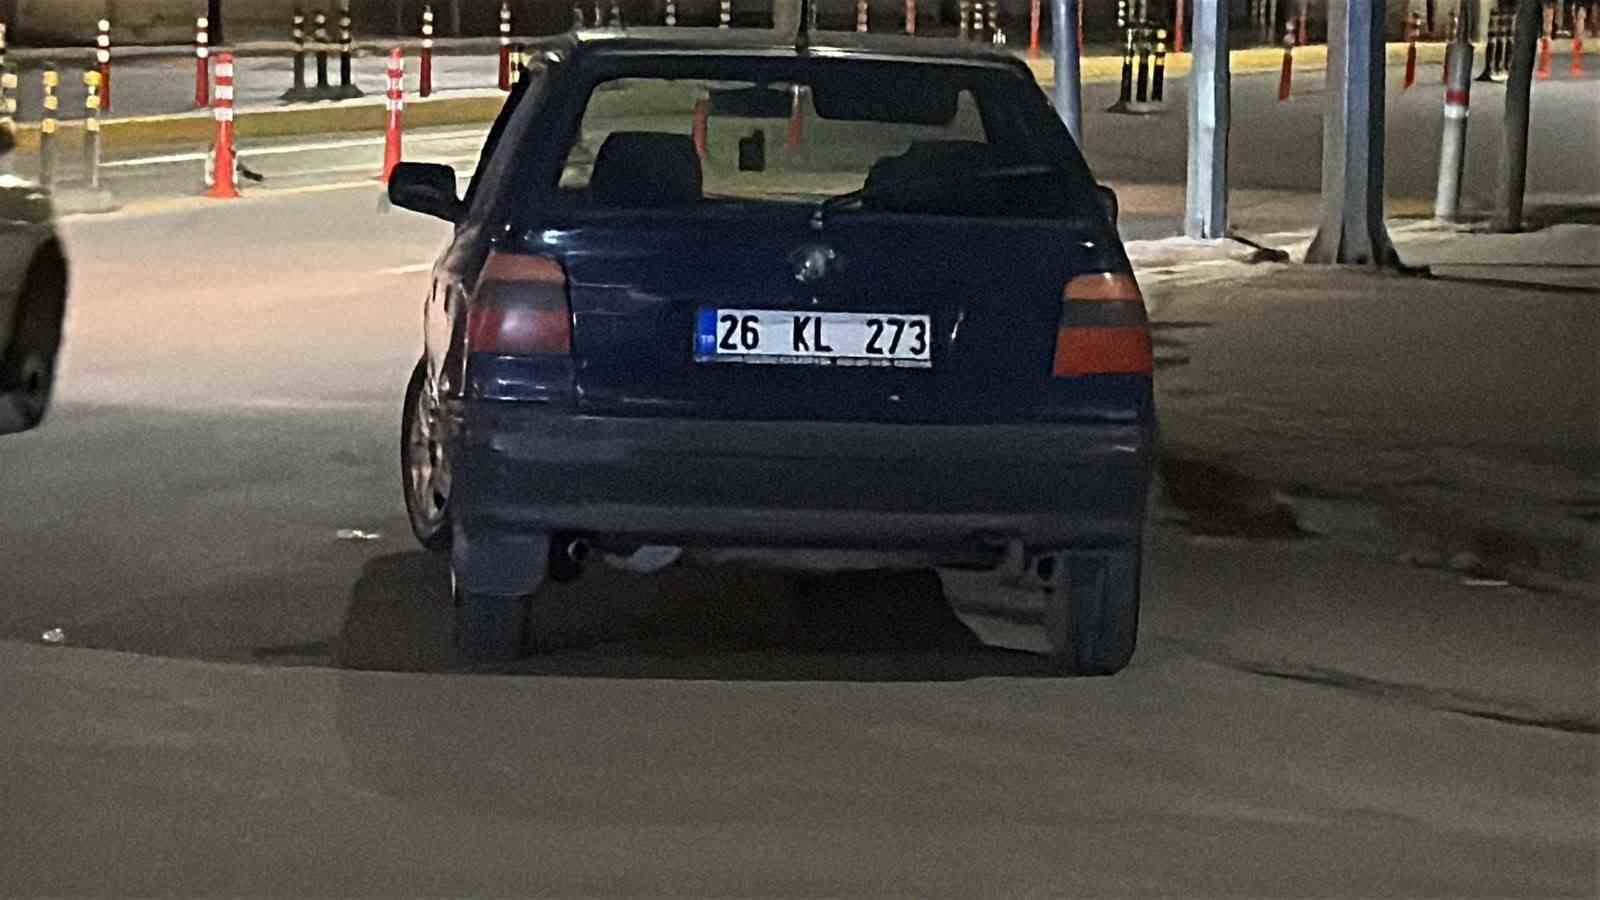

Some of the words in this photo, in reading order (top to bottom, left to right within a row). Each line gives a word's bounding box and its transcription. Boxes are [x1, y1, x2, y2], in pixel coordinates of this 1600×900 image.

[719, 314, 760, 350] 26
[792, 316, 833, 352] KL
[865, 318, 927, 354] 273
